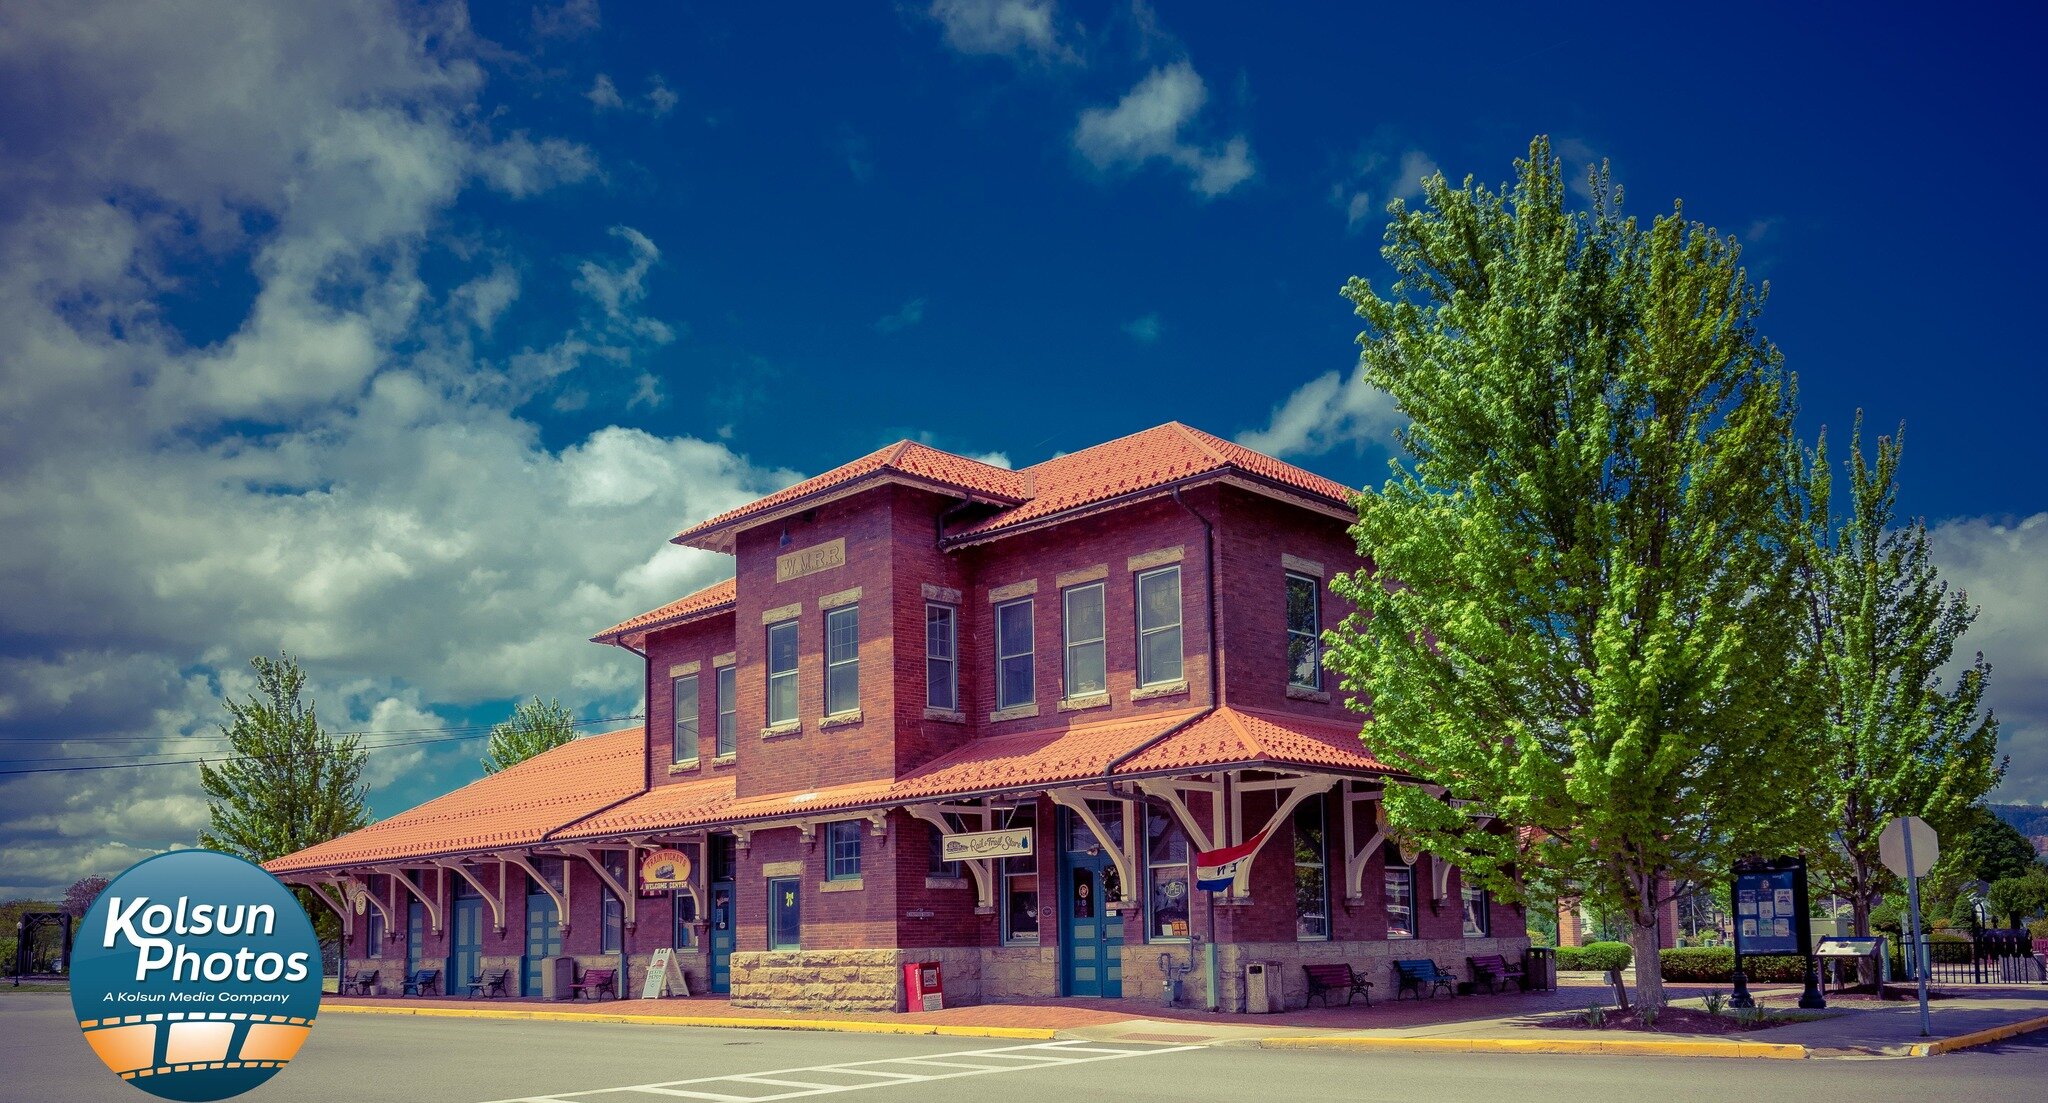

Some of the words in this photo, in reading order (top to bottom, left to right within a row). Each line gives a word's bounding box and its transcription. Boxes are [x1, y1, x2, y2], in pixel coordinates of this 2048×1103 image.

[970, 838, 984, 852] Rail
[1002, 835, 1021, 851] Store
[646, 853, 663, 869] TRAIN
[664, 852, 687, 867] TICKETS
[645, 882, 667, 890] WELCOME
[669, 881, 687, 889] CENTER
[1164, 884, 1185, 894] OPEN
